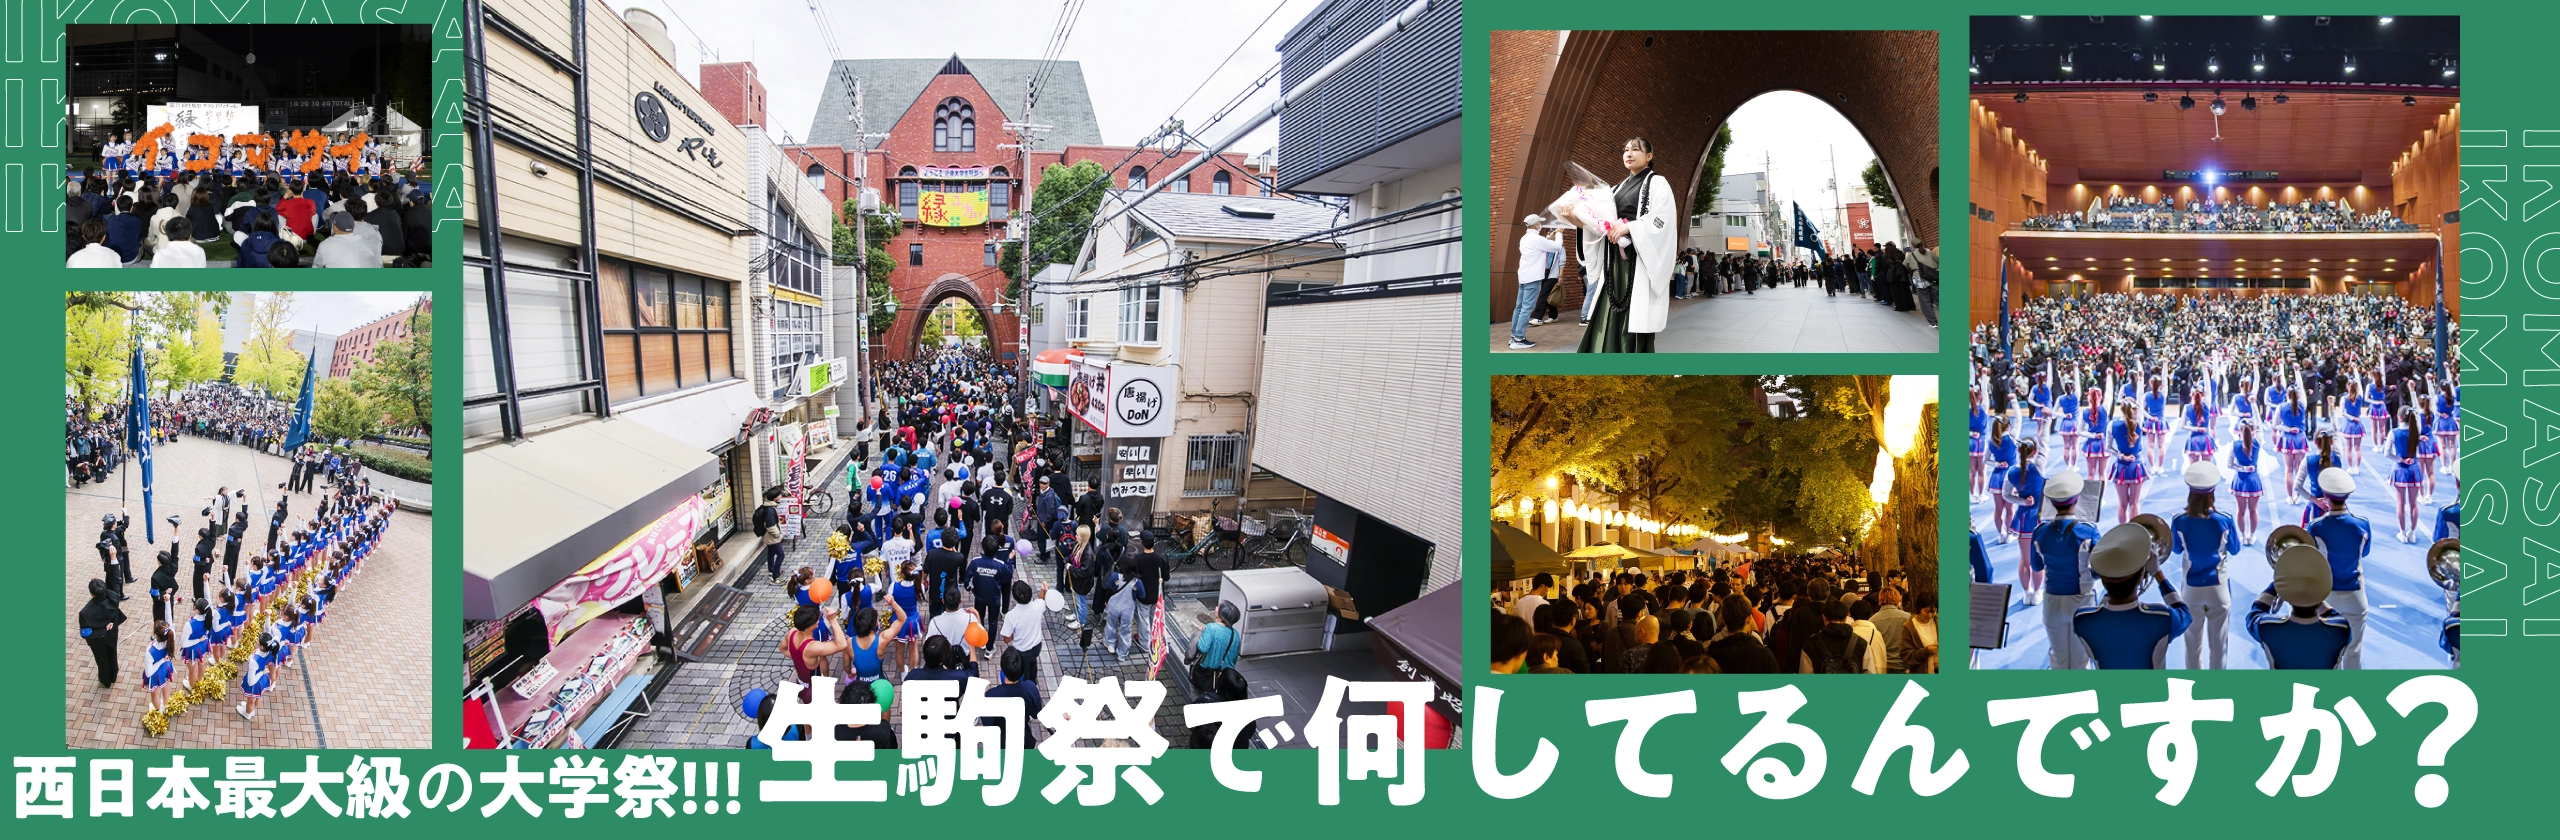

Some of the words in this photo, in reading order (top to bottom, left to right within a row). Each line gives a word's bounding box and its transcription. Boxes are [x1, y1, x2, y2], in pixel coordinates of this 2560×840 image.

[133, 121, 368, 174] イコマサイ
[1123, 386, 1158, 409] 唐揚げ
[1127, 409, 1149, 420] DoN
[883, 470, 897, 482] 26
